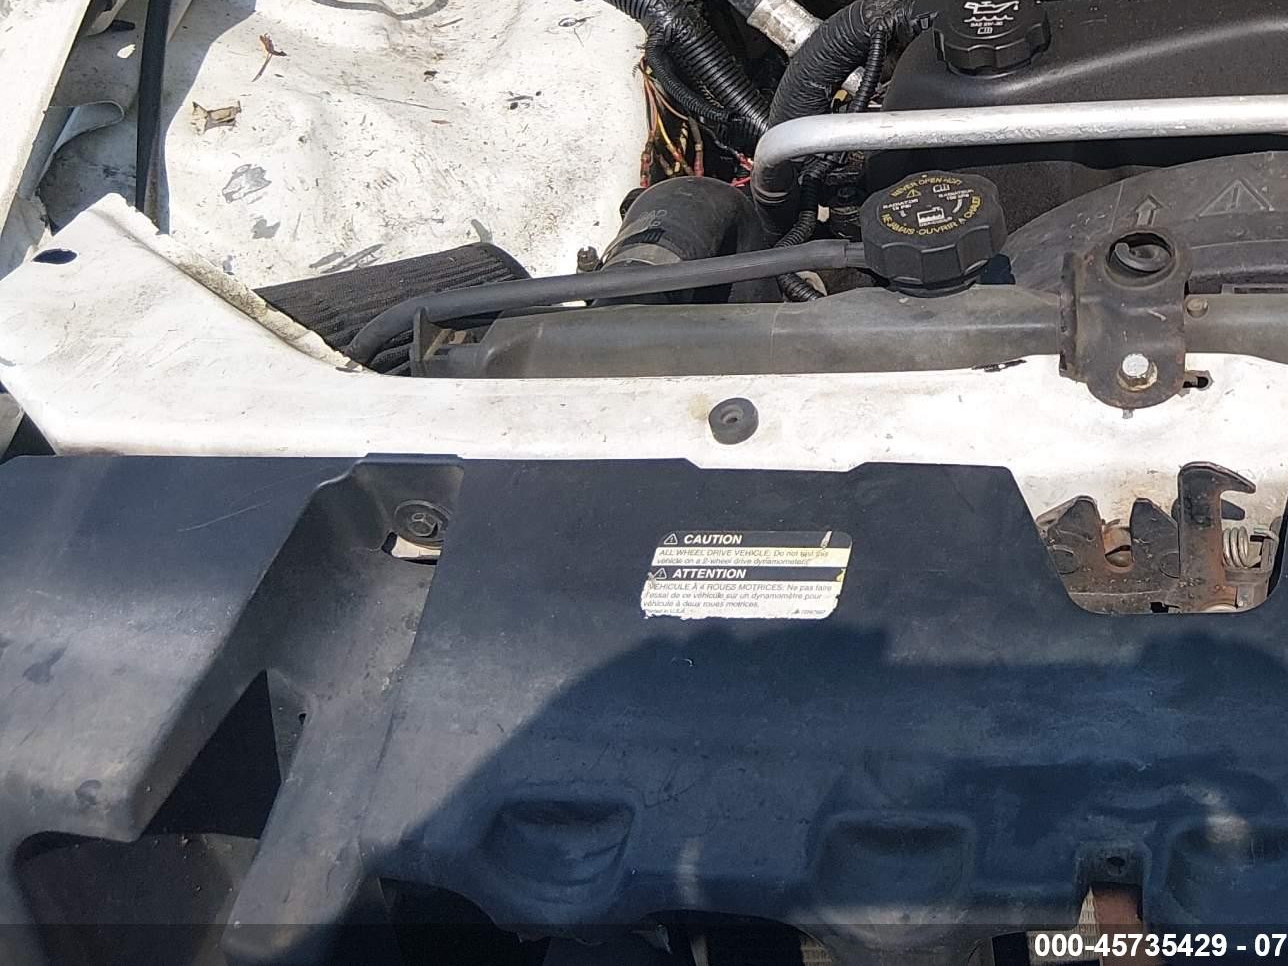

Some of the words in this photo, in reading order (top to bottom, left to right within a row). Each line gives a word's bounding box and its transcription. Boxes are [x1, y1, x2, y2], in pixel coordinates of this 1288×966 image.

[891, 180, 918, 197] NEVER
[918, 177, 942, 186] OPEN
[882, 198, 919, 209] RADIATOR
[919, 221, 958, 236] OUVRIR
[684, 534, 742, 545] CAUTION
[673, 568, 746, 579] ATTENTION
